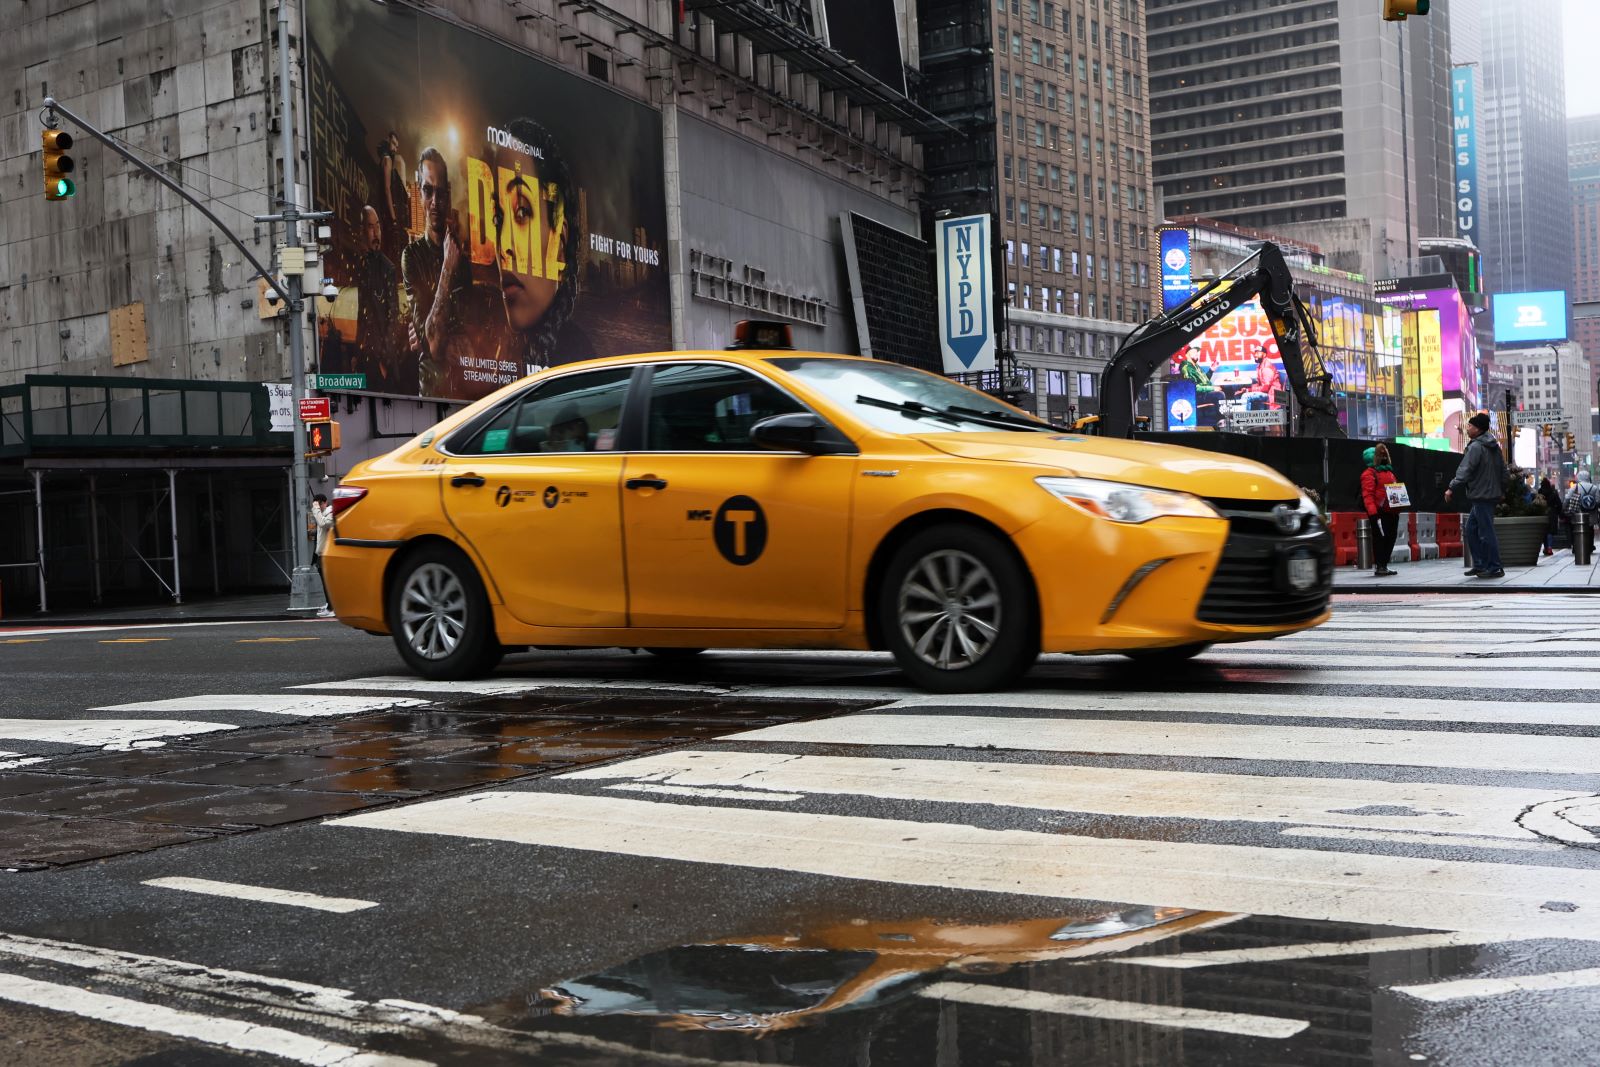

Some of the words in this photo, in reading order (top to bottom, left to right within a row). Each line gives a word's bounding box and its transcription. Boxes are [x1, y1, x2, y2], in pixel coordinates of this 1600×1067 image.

[1453, 79, 1471, 166] TIMES
[487, 126, 512, 149] max
[512, 139, 544, 160] ORIGINAL
[316, 157, 352, 225] LOVE
[467, 156, 566, 281] DMZ
[1457, 179, 1478, 249] SQUA
[590, 233, 614, 255] FIGHT
[616, 240, 631, 260] FOR
[633, 245, 659, 266] YOURS
[956, 226, 974, 335] NYPD
[1181, 300, 1230, 333] VOLVO
[1205, 315, 1273, 338] ESUS
[460, 356, 474, 367] NEW
[475, 358, 498, 370] LIMITED
[499, 360, 518, 373] SERIES
[464, 370, 498, 383] STREAMING
[499, 374, 511, 384] MAR
[319, 376, 363, 389] Broadway
[687, 509, 712, 521] NYC
[725, 510, 755, 557] T
